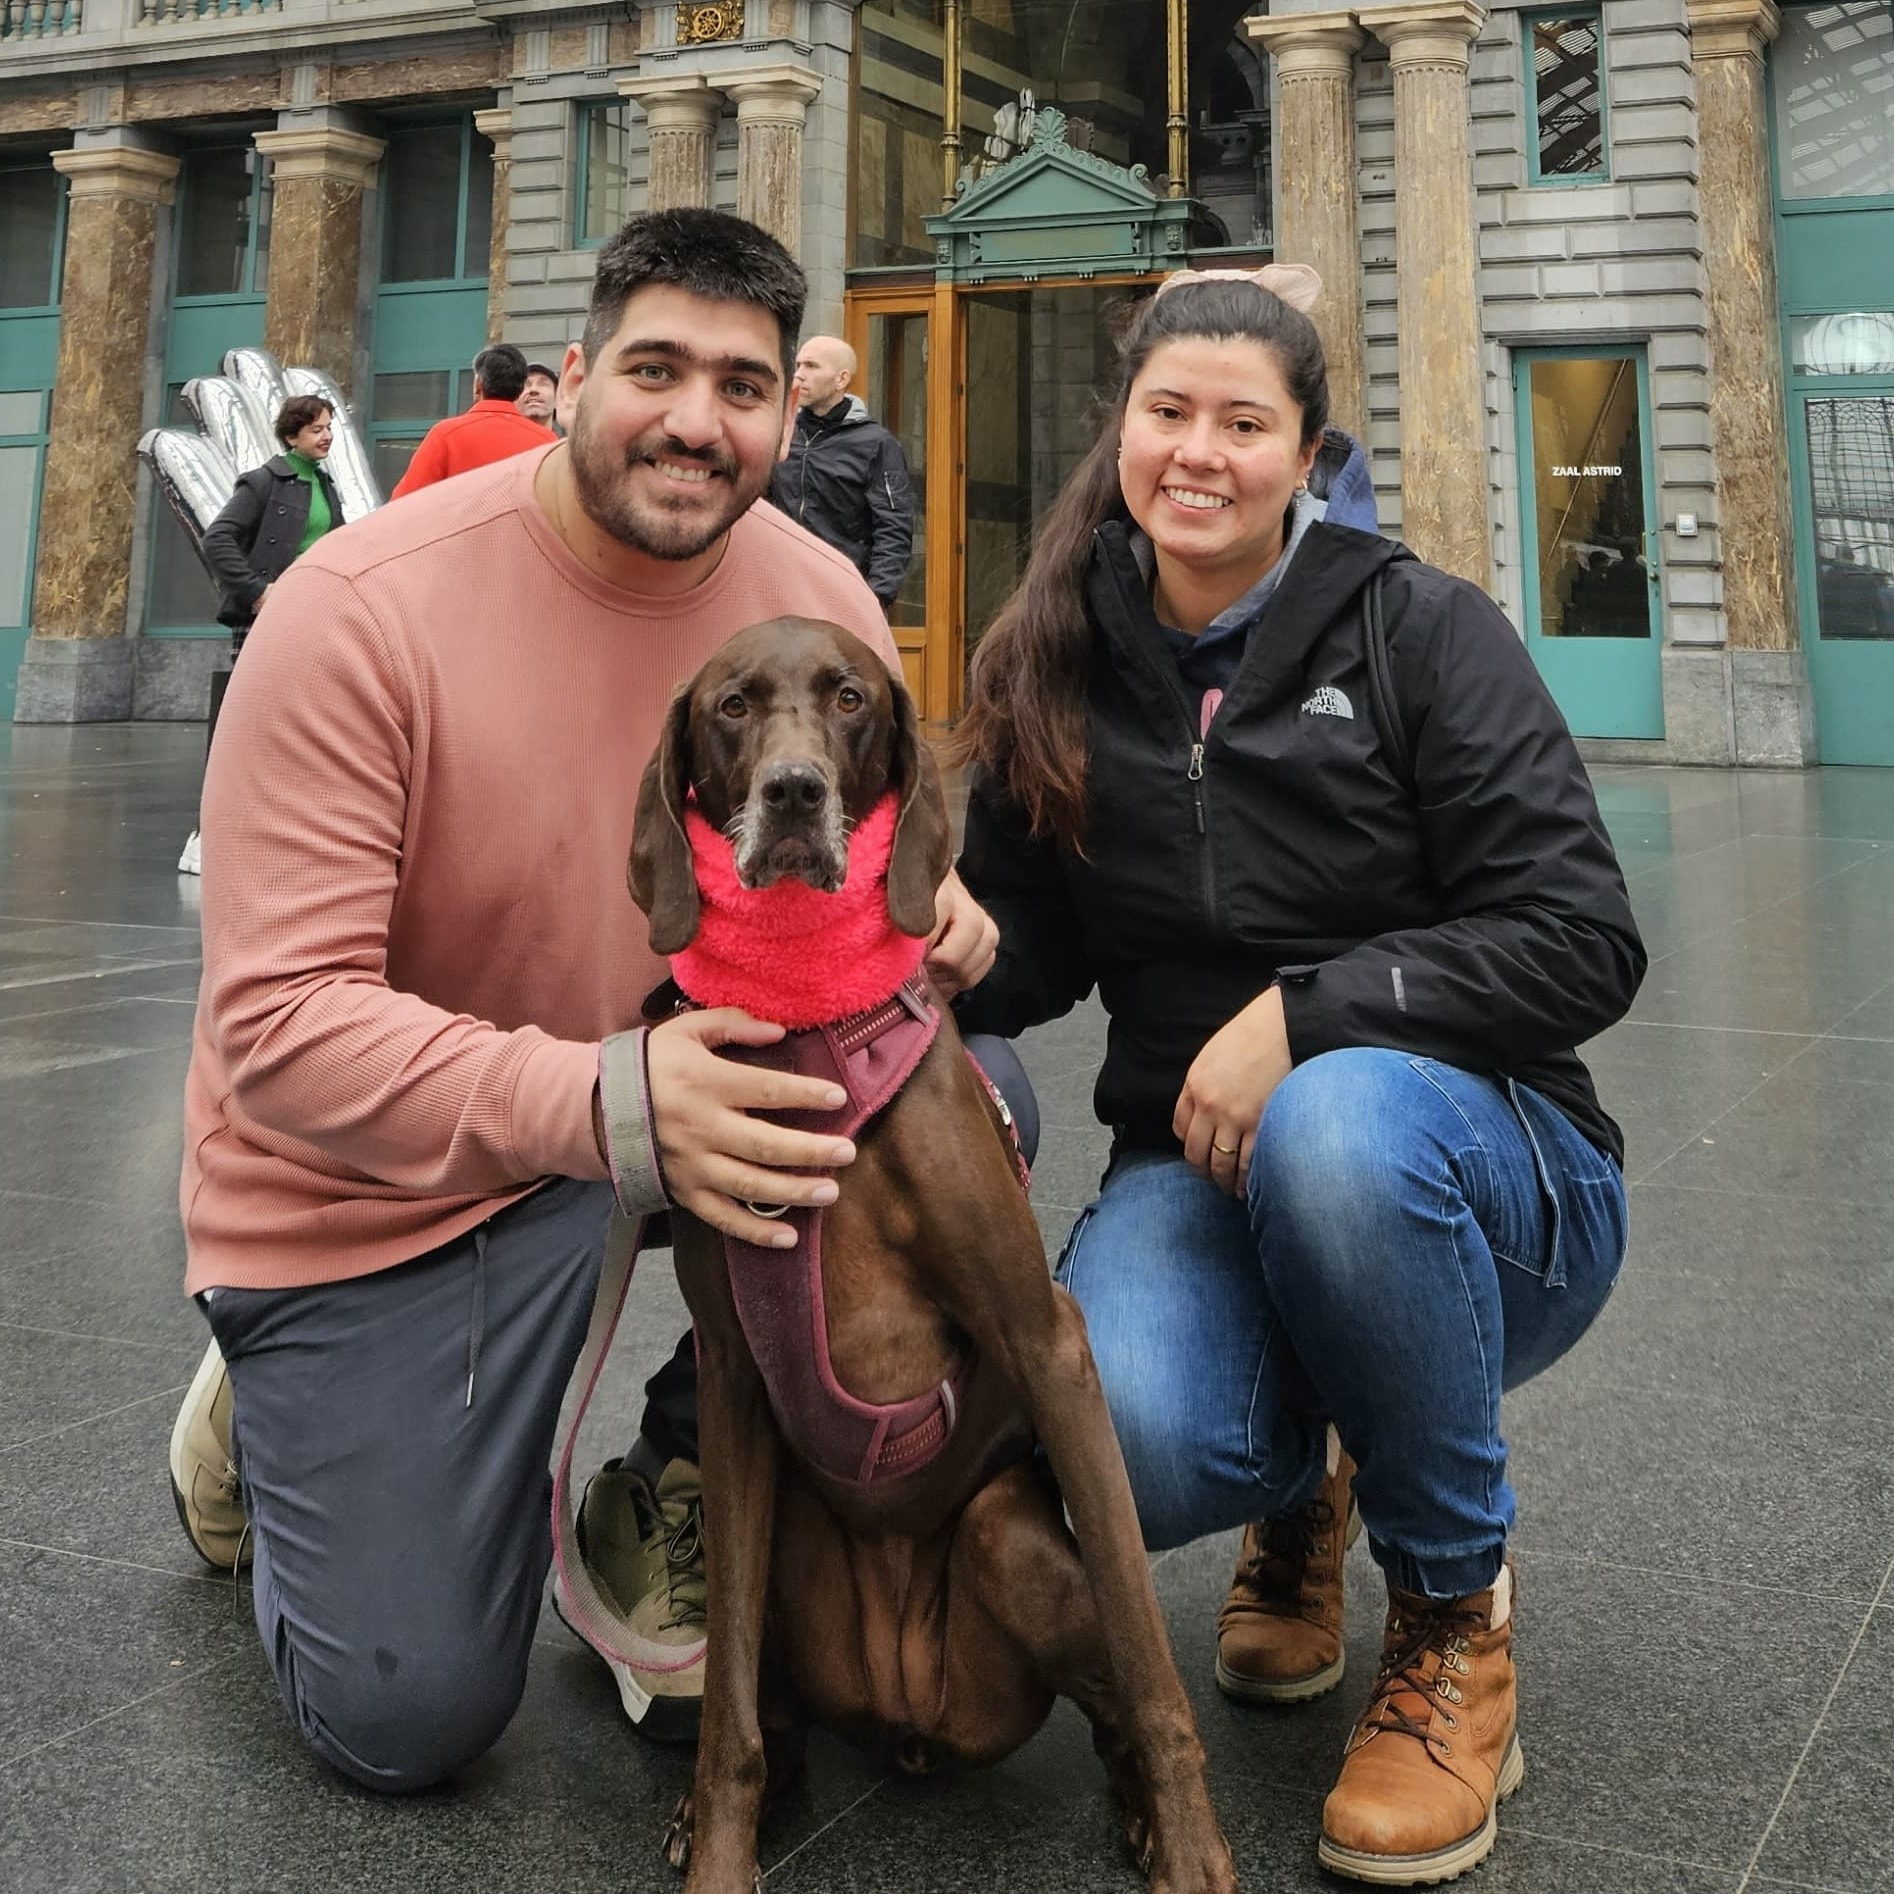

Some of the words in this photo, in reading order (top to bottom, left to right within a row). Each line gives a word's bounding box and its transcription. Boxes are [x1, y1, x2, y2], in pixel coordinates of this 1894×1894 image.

[1552, 466, 1581, 476] ZAAL
[1582, 466, 1622, 476] ASTRID
[1315, 687, 1336, 698] THE
[1301, 696, 1336, 711] NORTH
[1310, 705, 1337, 716] FACE
